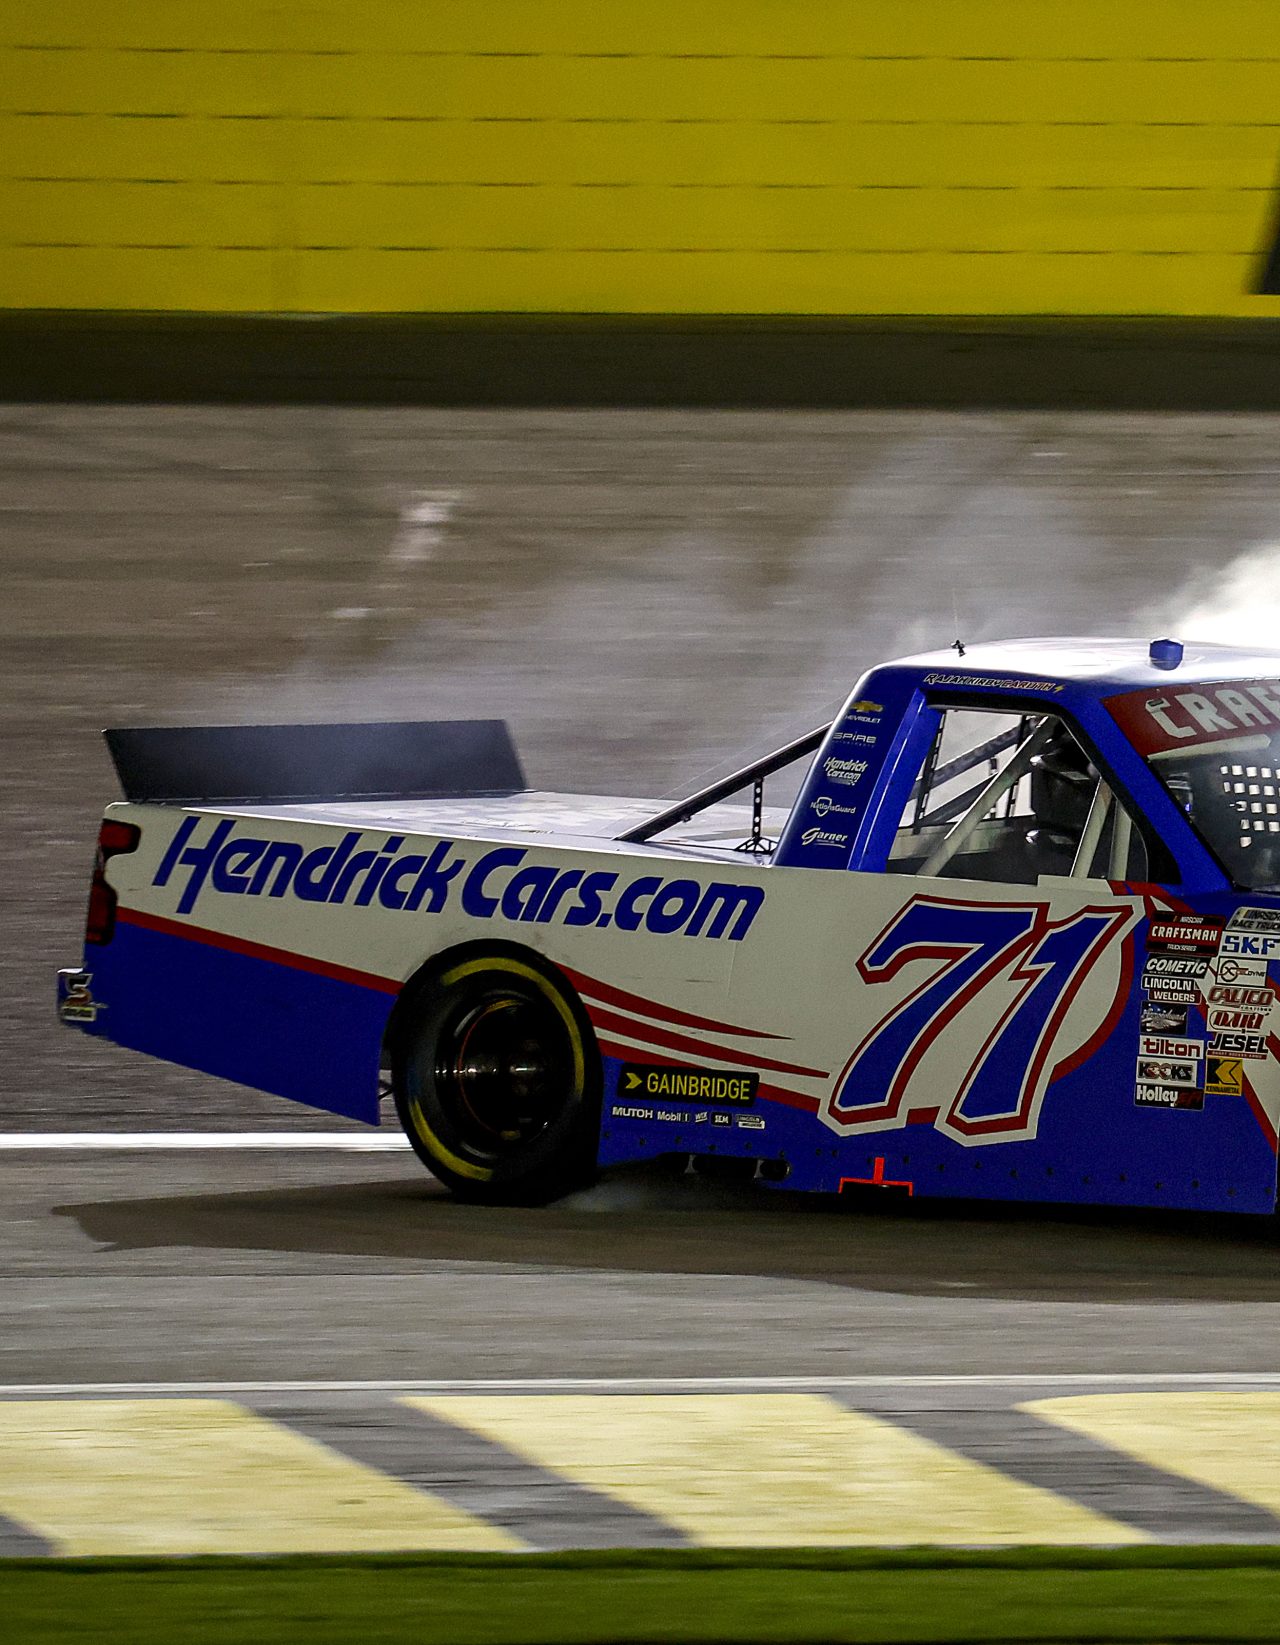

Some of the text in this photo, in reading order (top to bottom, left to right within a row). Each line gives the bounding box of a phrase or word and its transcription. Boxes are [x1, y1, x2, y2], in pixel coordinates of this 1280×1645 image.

[823, 756, 868, 773] Hendrick
[827, 768, 861, 783] Cars.com
[801, 827, 848, 846] Garner
[1180, 916, 1204, 924] NASCAR
[1231, 919, 1255, 929] RACE
[1151, 925, 1218, 942] CRAFTSMAN
[1222, 935, 1280, 955] SKF
[1146, 958, 1207, 974] COMETIC
[1144, 977, 1192, 991] LINCOLN
[1153, 990, 1195, 1002] WELDERS
[1208, 988, 1274, 1006] CALICO
[826, 893, 1136, 1140] 71
[1143, 1037, 1201, 1058] tilton
[1208, 1033, 1268, 1053] JESEL
[1138, 1061, 1193, 1082] KOOKS
[647, 1072, 750, 1100] GAINBRIDGE
[1136, 1084, 1179, 1108] Holley
[612, 1106, 653, 1119] MUTOH
[657, 1111, 681, 1122] Mobil
